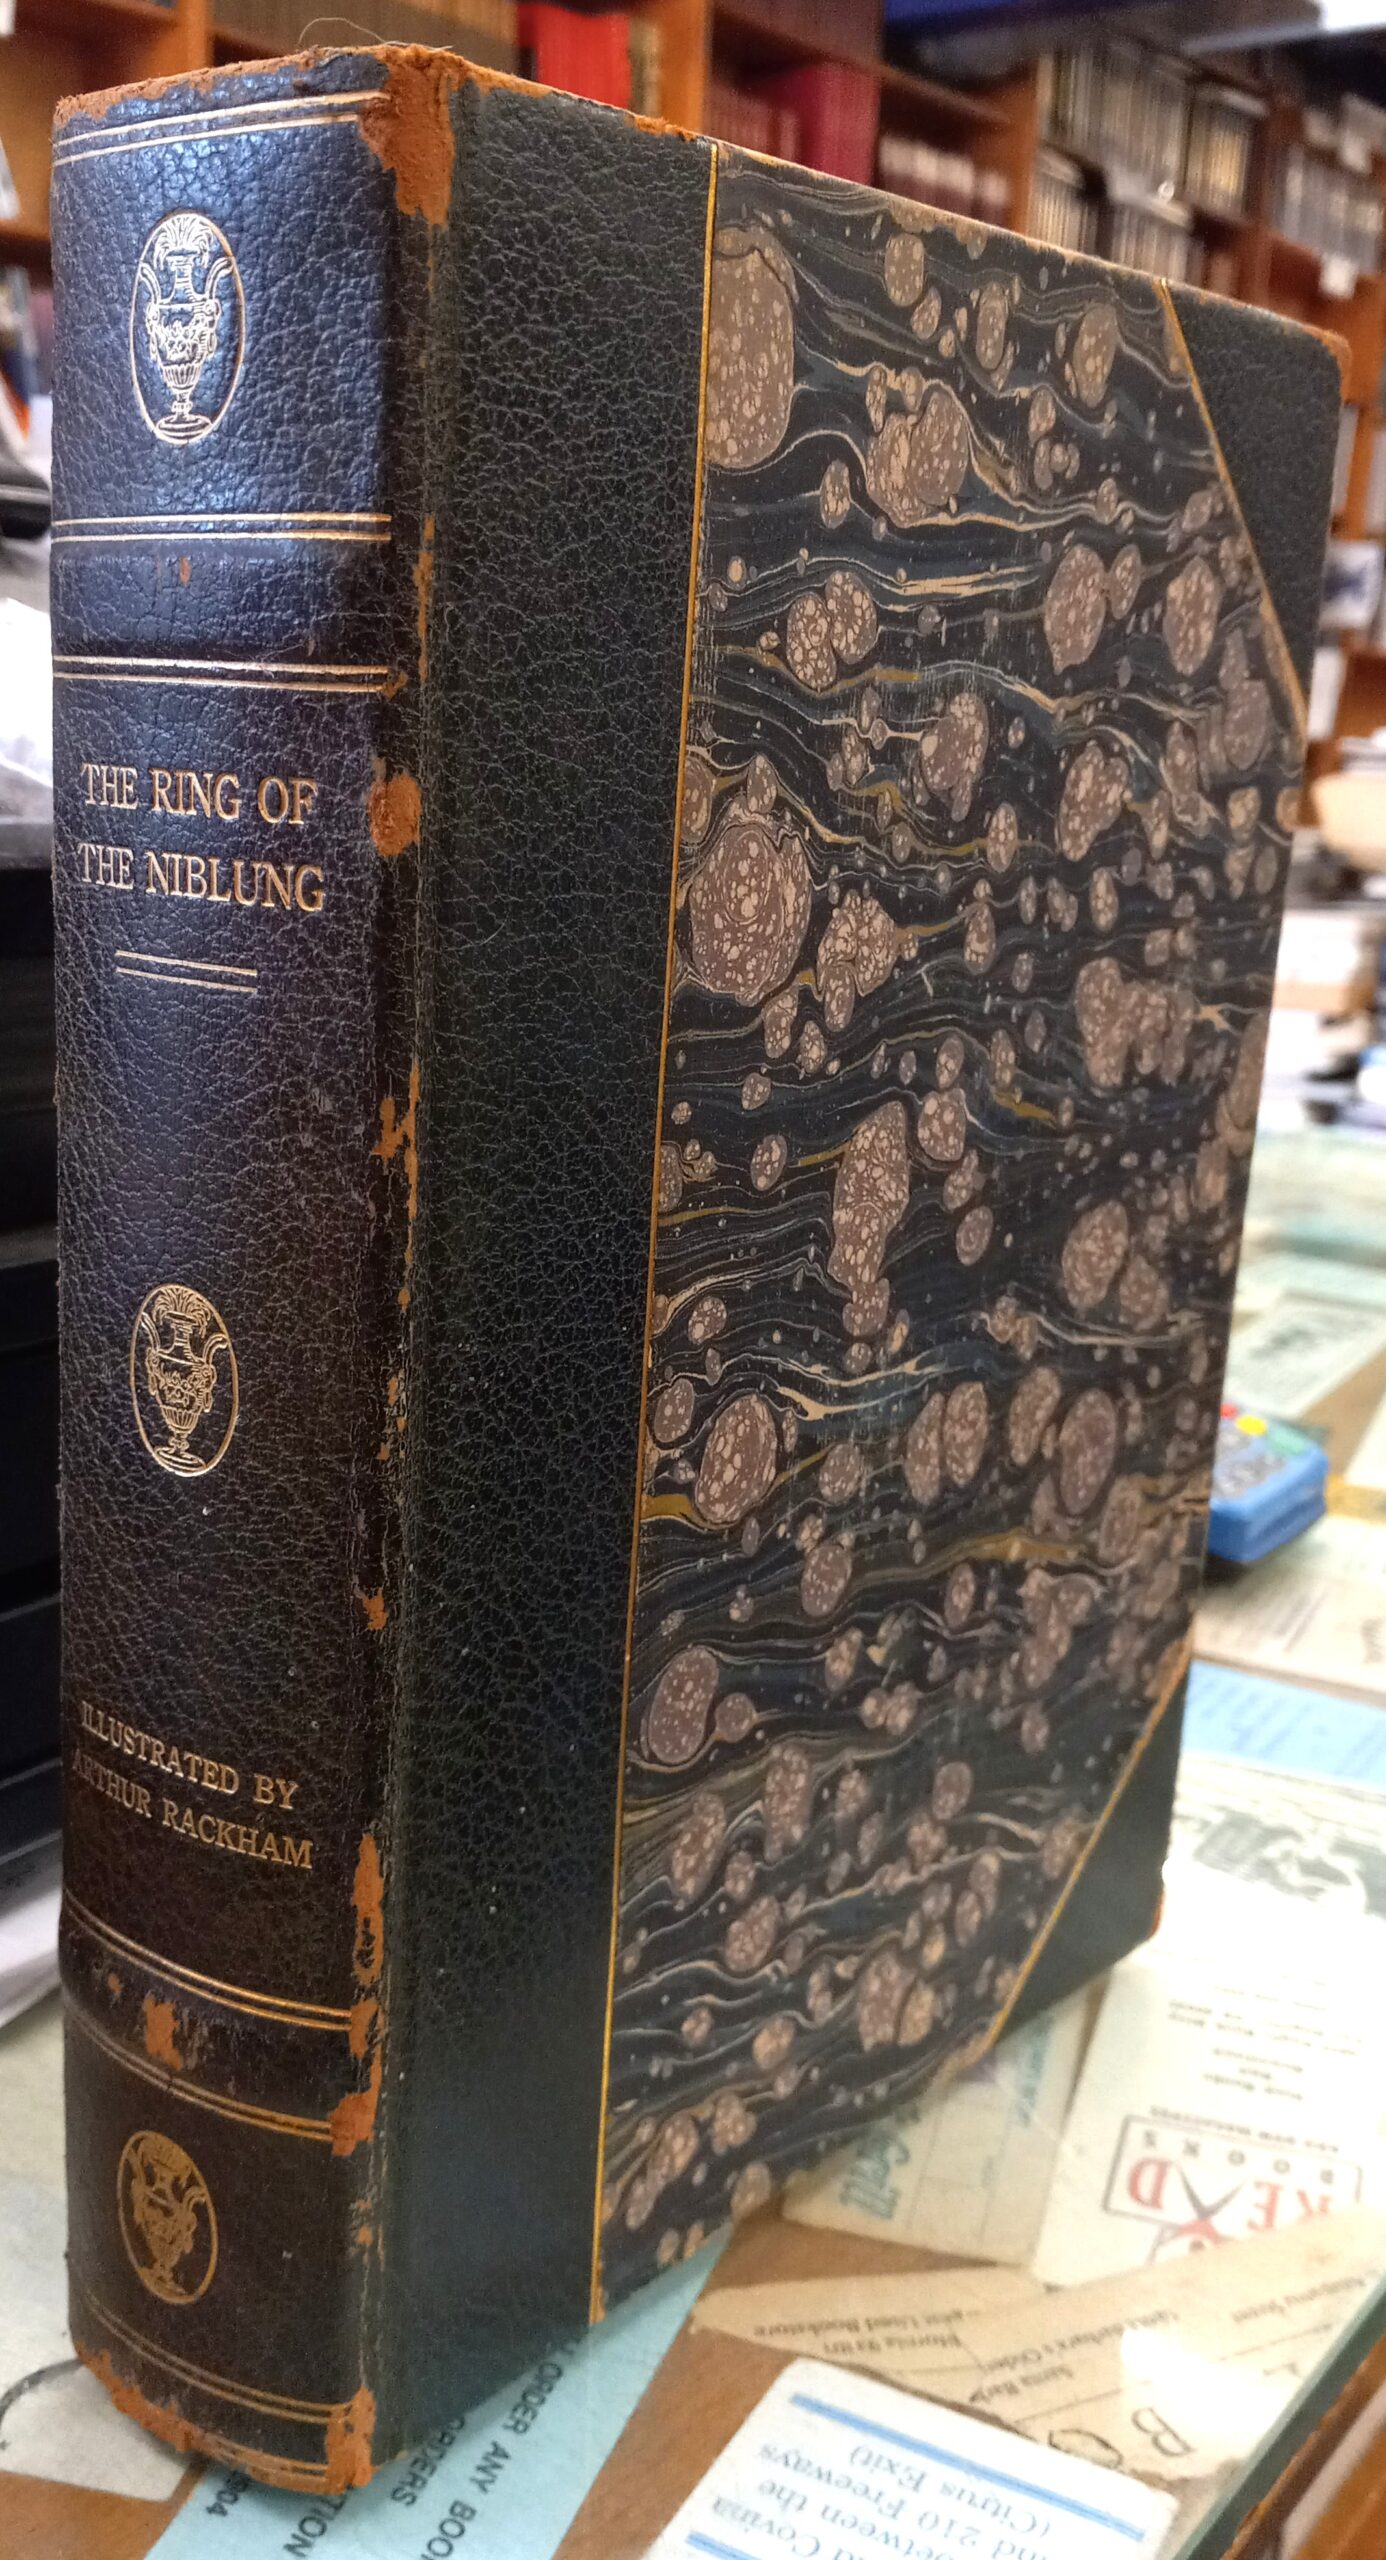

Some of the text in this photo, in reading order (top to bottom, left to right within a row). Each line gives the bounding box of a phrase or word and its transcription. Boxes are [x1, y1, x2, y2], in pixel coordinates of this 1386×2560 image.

[81, 762, 318, 825] THE RING OF
[79, 842, 326, 912] THE NIBLUNG
[82, 1701, 299, 1810] ILLUSTRATED BY
[73, 1749, 314, 1869] ARTHUR RACKHAM
[503, 2362, 563, 2434] ORDER
[470, 2441, 511, 2494] ANY
[758, 2443, 907, 2521] Freeways
[758, 2478, 809, 2512] the
[849, 2443, 1051, 2538] (Citrus Exit)
[283, 2488, 350, 2559] TION
[421, 2500, 477, 2560] BOO
[711, 2495, 821, 2557] Covina
[917, 2509, 982, 2549] 210
